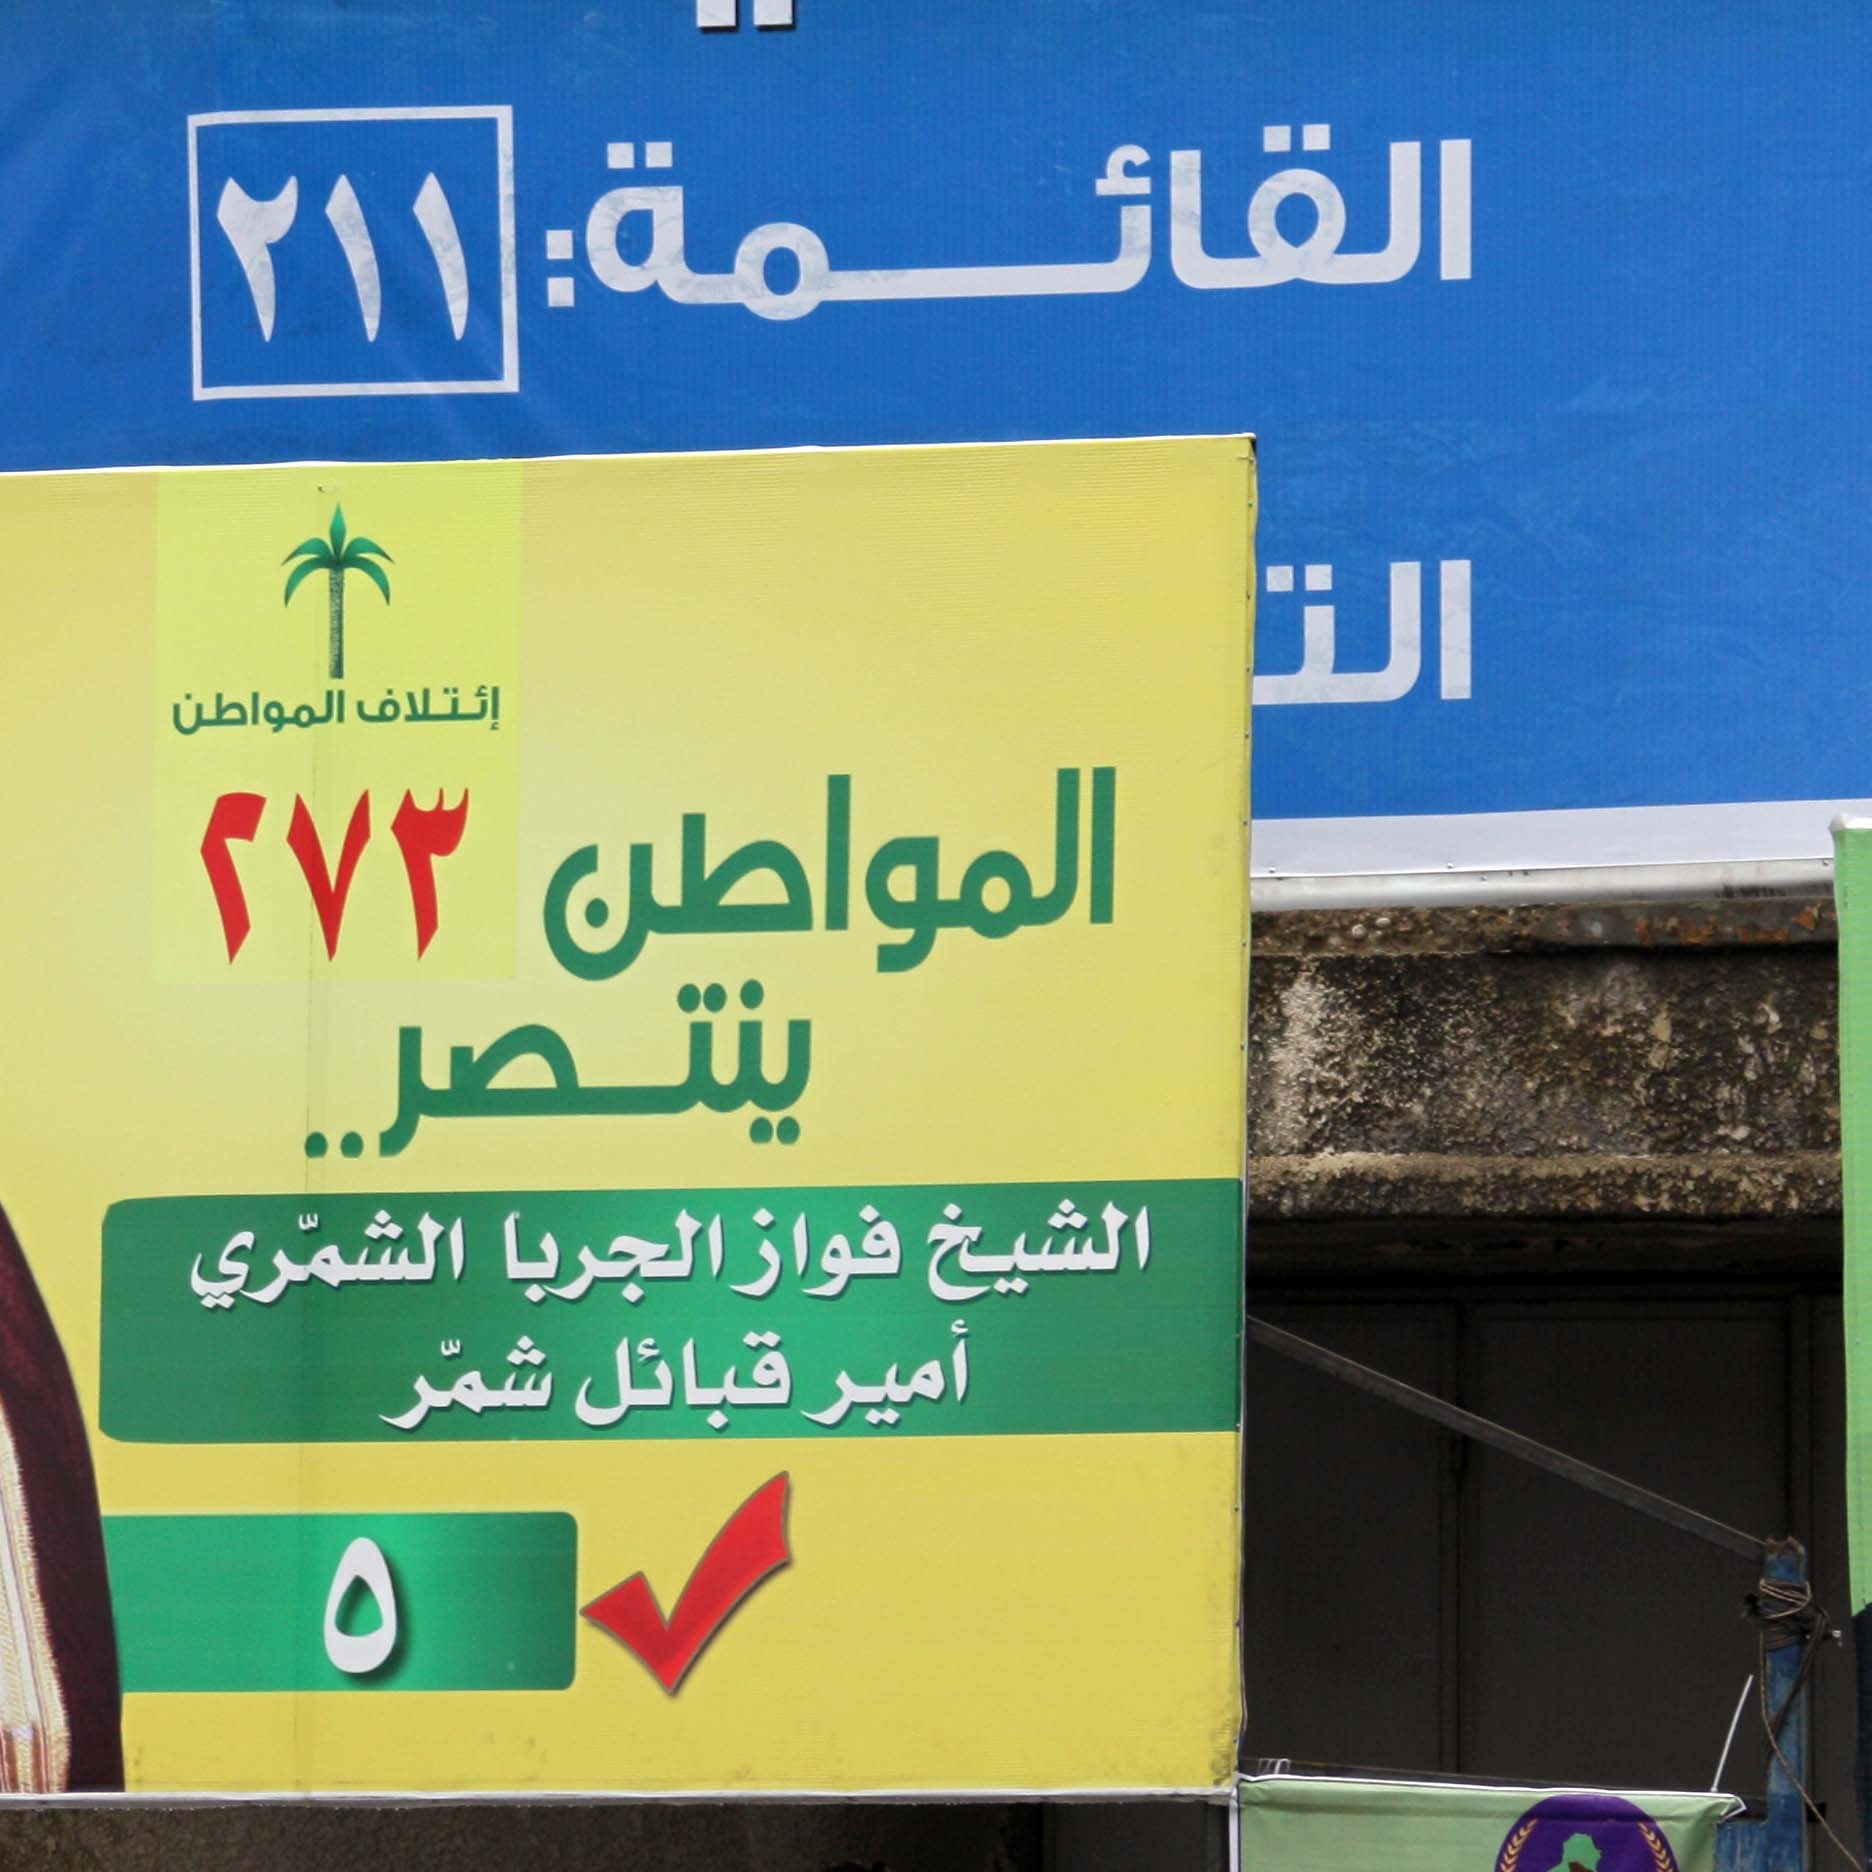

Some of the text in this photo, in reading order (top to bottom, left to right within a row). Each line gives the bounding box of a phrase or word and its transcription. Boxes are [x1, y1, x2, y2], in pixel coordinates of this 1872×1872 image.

[214, 169, 472, 345] ٢١١
[171, 683, 502, 735] إئتلاف المواطن
[199, 786, 470, 966] ٢٧٣
[542, 765, 1117, 982] المواطن
[503, 1208, 726, 1304] الجربا
[730, 1203, 903, 1301] فواز
[927, 1195, 1154, 1301] الشيخ
[576, 1330, 792, 1432] قبائل
[801, 1318, 970, 1428] أمير
[322, 1536, 399, 1674] ٥
